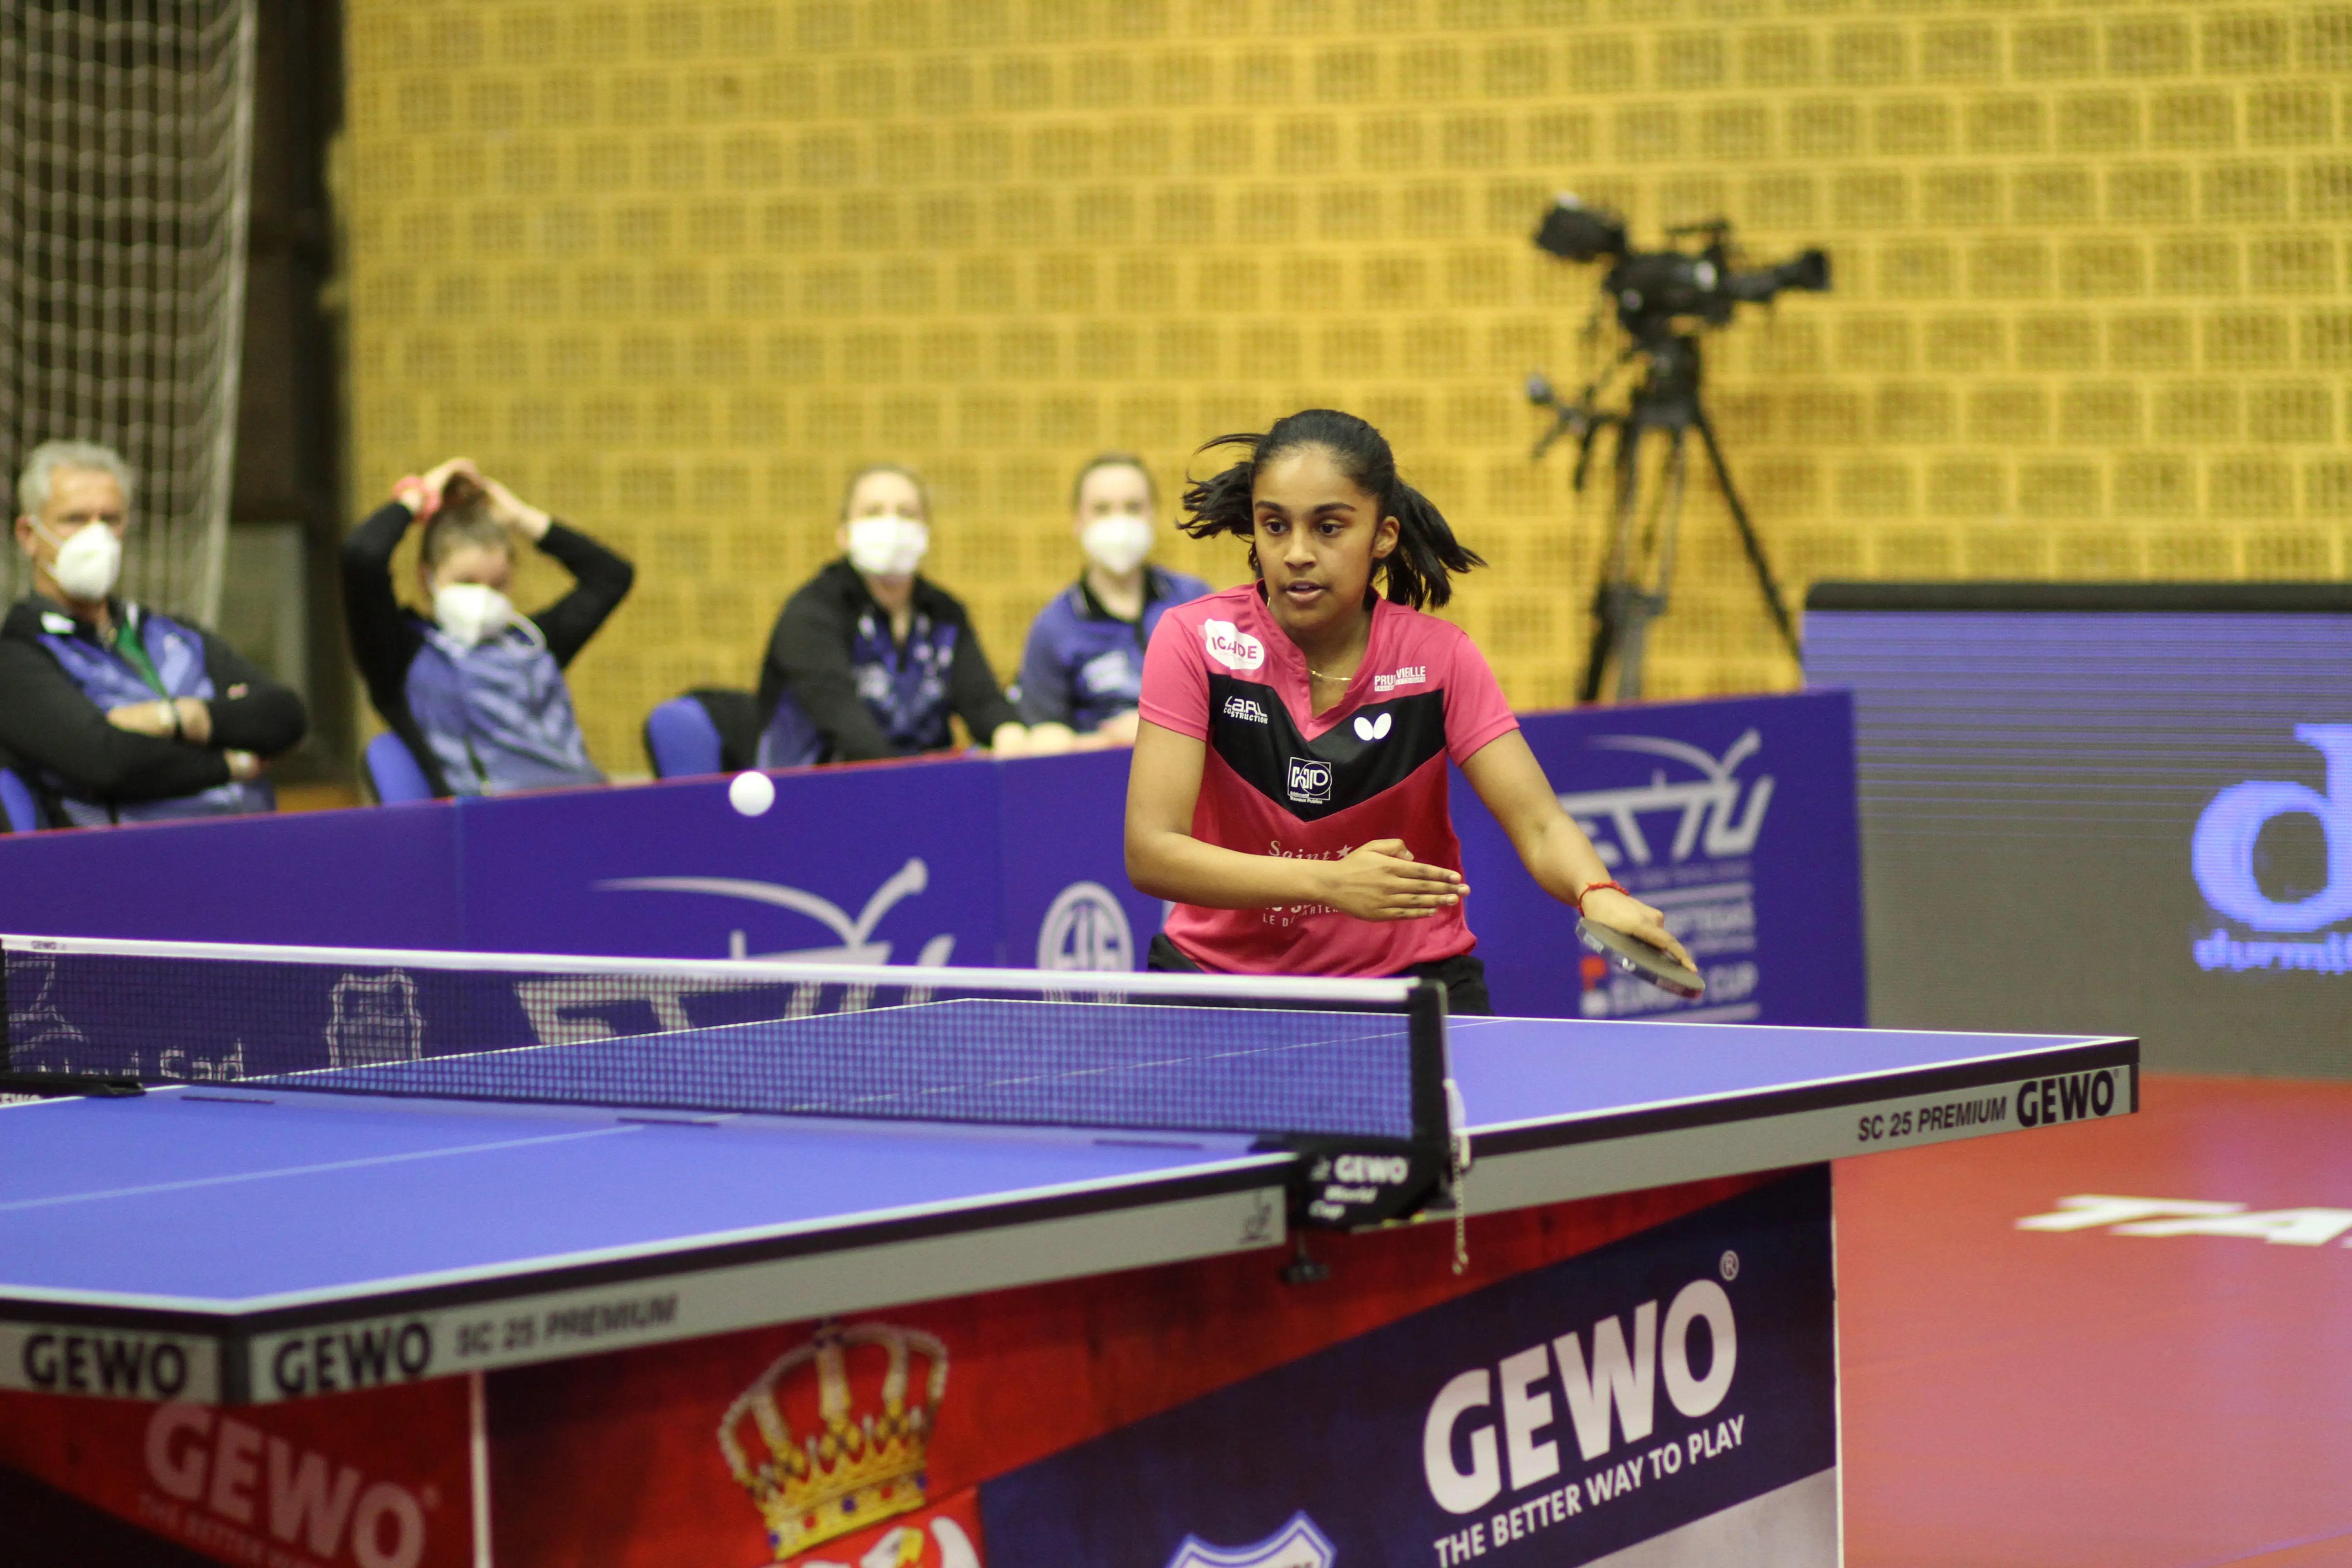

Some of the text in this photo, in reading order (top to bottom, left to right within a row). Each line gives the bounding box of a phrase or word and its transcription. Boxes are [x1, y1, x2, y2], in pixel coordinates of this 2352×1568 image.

[1212, 636, 1257, 659] ICADE
[1269, 840, 1332, 860] Saint
[1858, 1069, 2114, 1142] SC 25 PREMIUM GEWO
[1334, 1154, 1408, 1185] GEWO
[22, 1333, 187, 1394] GEWO
[274, 1292, 678, 1393] GEWO SC 25 PREMIUM
[1423, 1279, 1737, 1514] GEWO
[143, 1398, 426, 1568] GEWO
[1433, 1414, 1744, 1568] THE BETTER WAY TO PLAY
